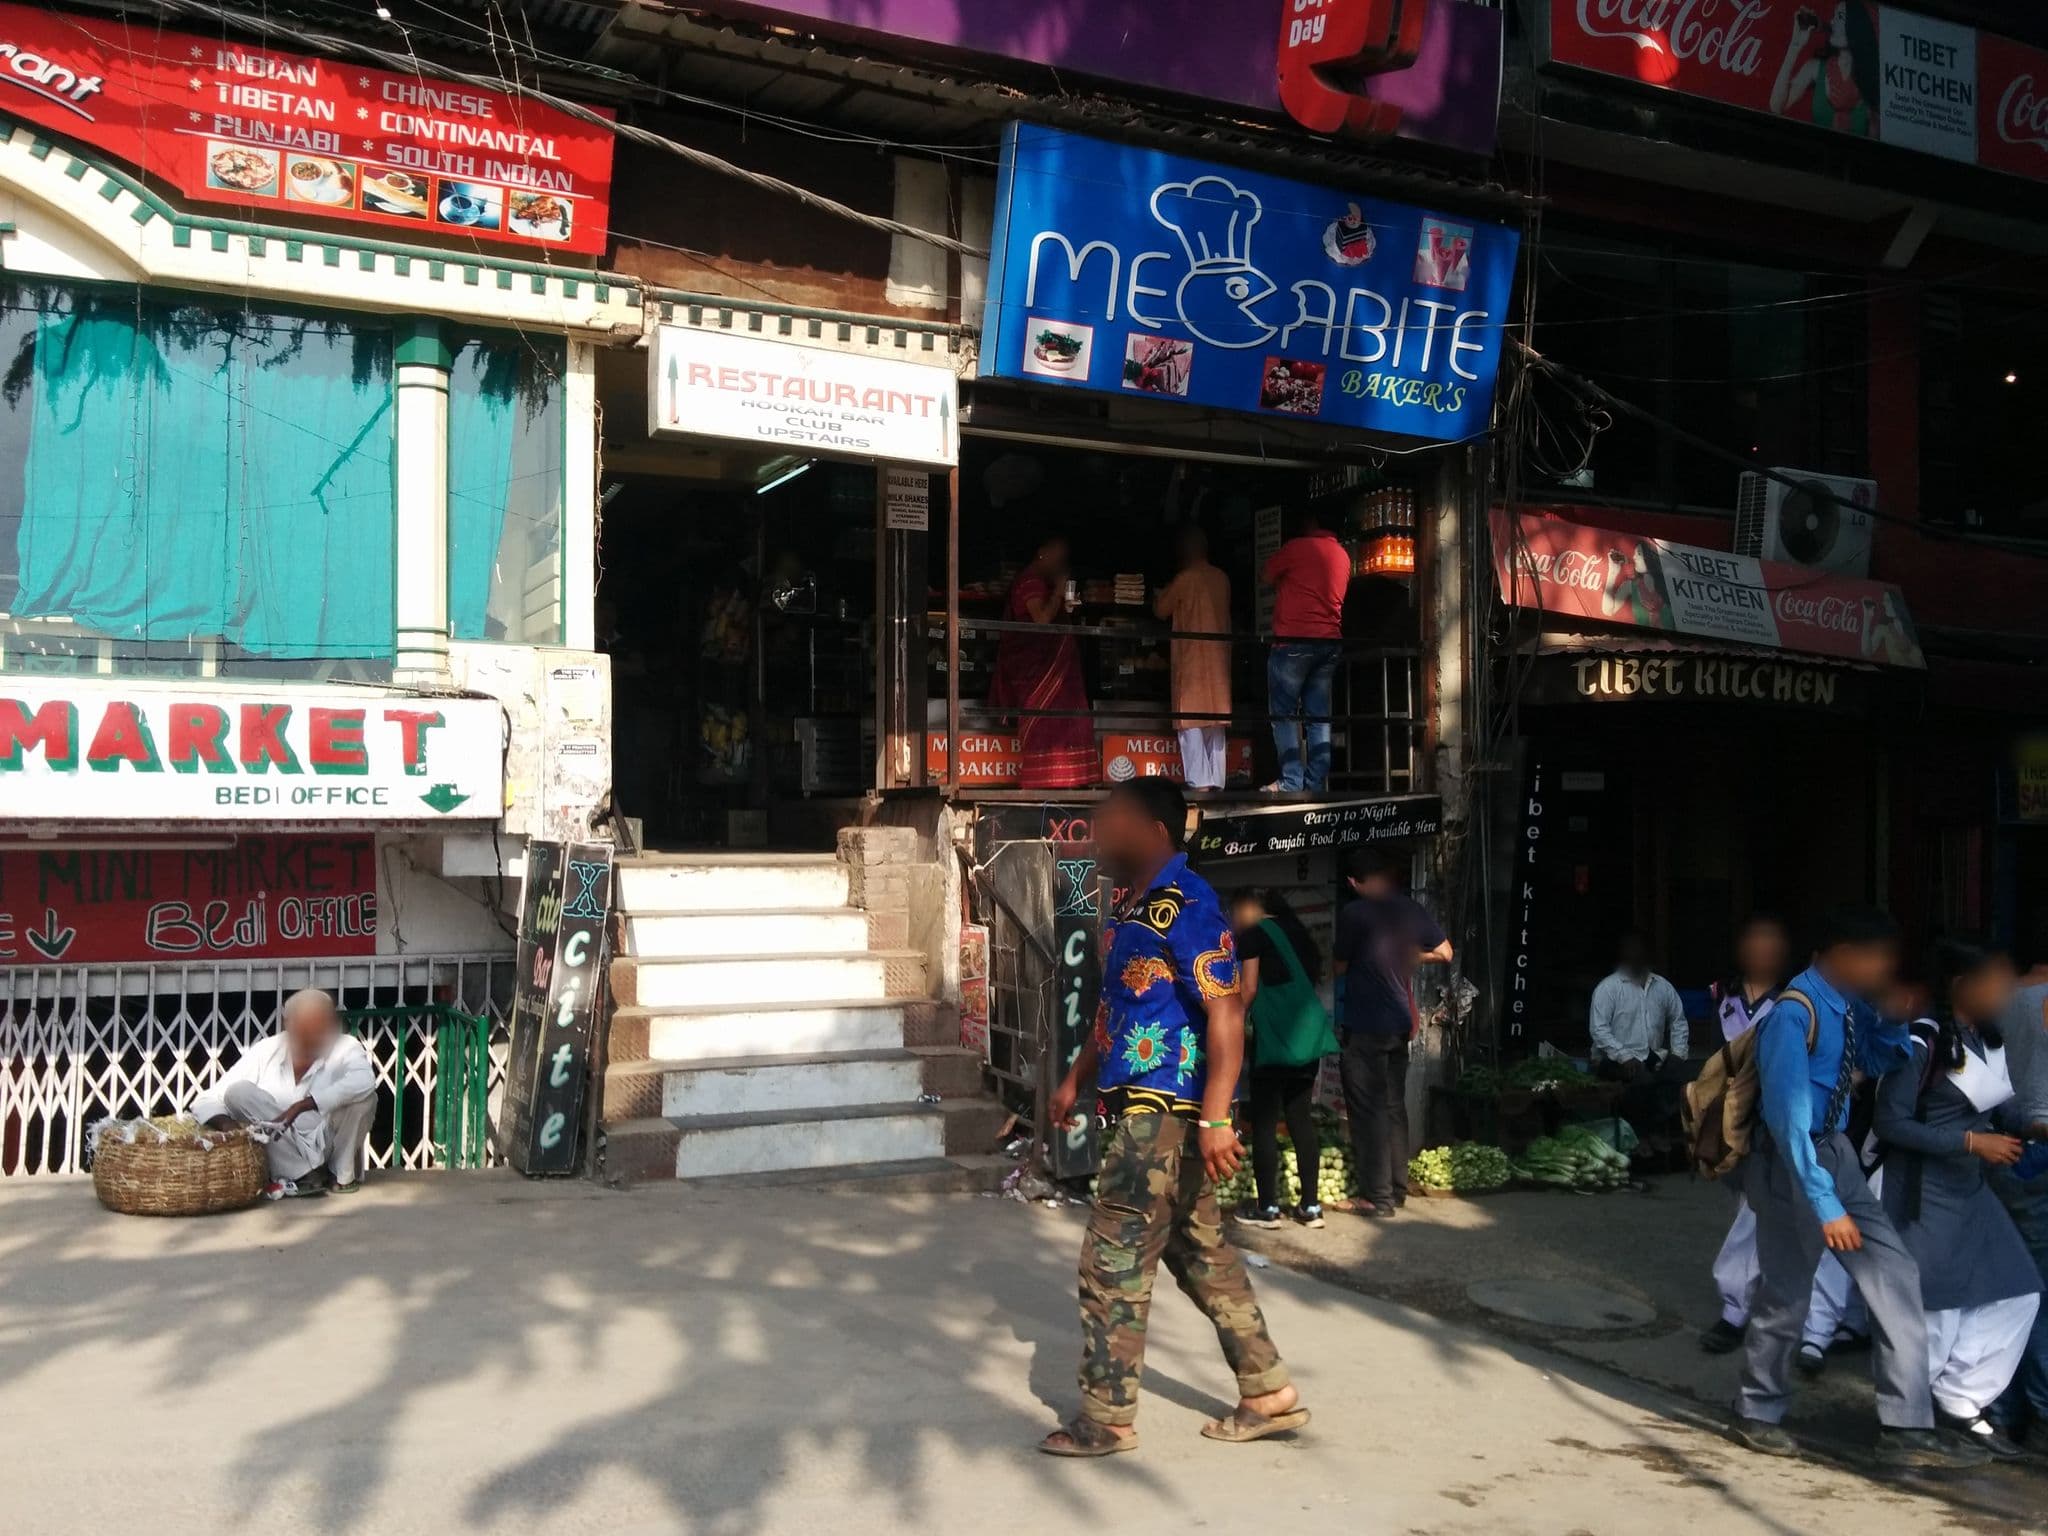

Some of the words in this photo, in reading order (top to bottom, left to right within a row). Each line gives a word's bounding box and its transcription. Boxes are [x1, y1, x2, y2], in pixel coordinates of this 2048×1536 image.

[1289, 14, 1326, 48] Day
[216, 50, 317, 87] INDIAN
[1899, 33, 1957, 69] TIBET
[214, 81, 335, 121] TIBETAN
[382, 81, 493, 119] CHINESE
[1885, 62, 1972, 106] KITCHEN
[214, 113, 340, 153] PUNJABI
[380, 111, 561, 161] CONTINANTAL
[386, 143, 474, 176] SOUTH
[484, 160, 573, 192] INDIAN
[688, 362, 935, 418] RESTAURANT
[1341, 369, 1466, 413] BAKER'S
[741, 400, 833, 418] HOOKAH
[840, 413, 885, 425] BAR
[785, 417, 843, 432] CLUB
[757, 425, 870, 448] UPSTAIRS
[1680, 552, 1739, 580] TIBET
[1672, 577, 1764, 611] KITCHEN
[1693, 658, 1838, 704] KITCHEN
[0, 698, 446, 776] MARKET
[933, 738, 1002, 753] MGHA
[215, 786, 280, 805] BEDI
[292, 786, 389, 806] OFFICE
[1303, 811, 1341, 826] Party
[1344, 810, 1356, 822] to
[1360, 803, 1398, 822] Night
[1225, 840, 1257, 855] Bar
[1268, 833, 1306, 852] Punjabi
[1310, 830, 1334, 846] Food
[1338, 829, 1360, 844] Also
[1365, 823, 1411, 842] Available
[1414, 821, 1437, 835] Here
[38, 848, 153, 904] MINI
[181, 838, 371, 899] MARKET
[146, 891, 267, 952] Bedi
[278, 893, 377, 939] OFFICE
